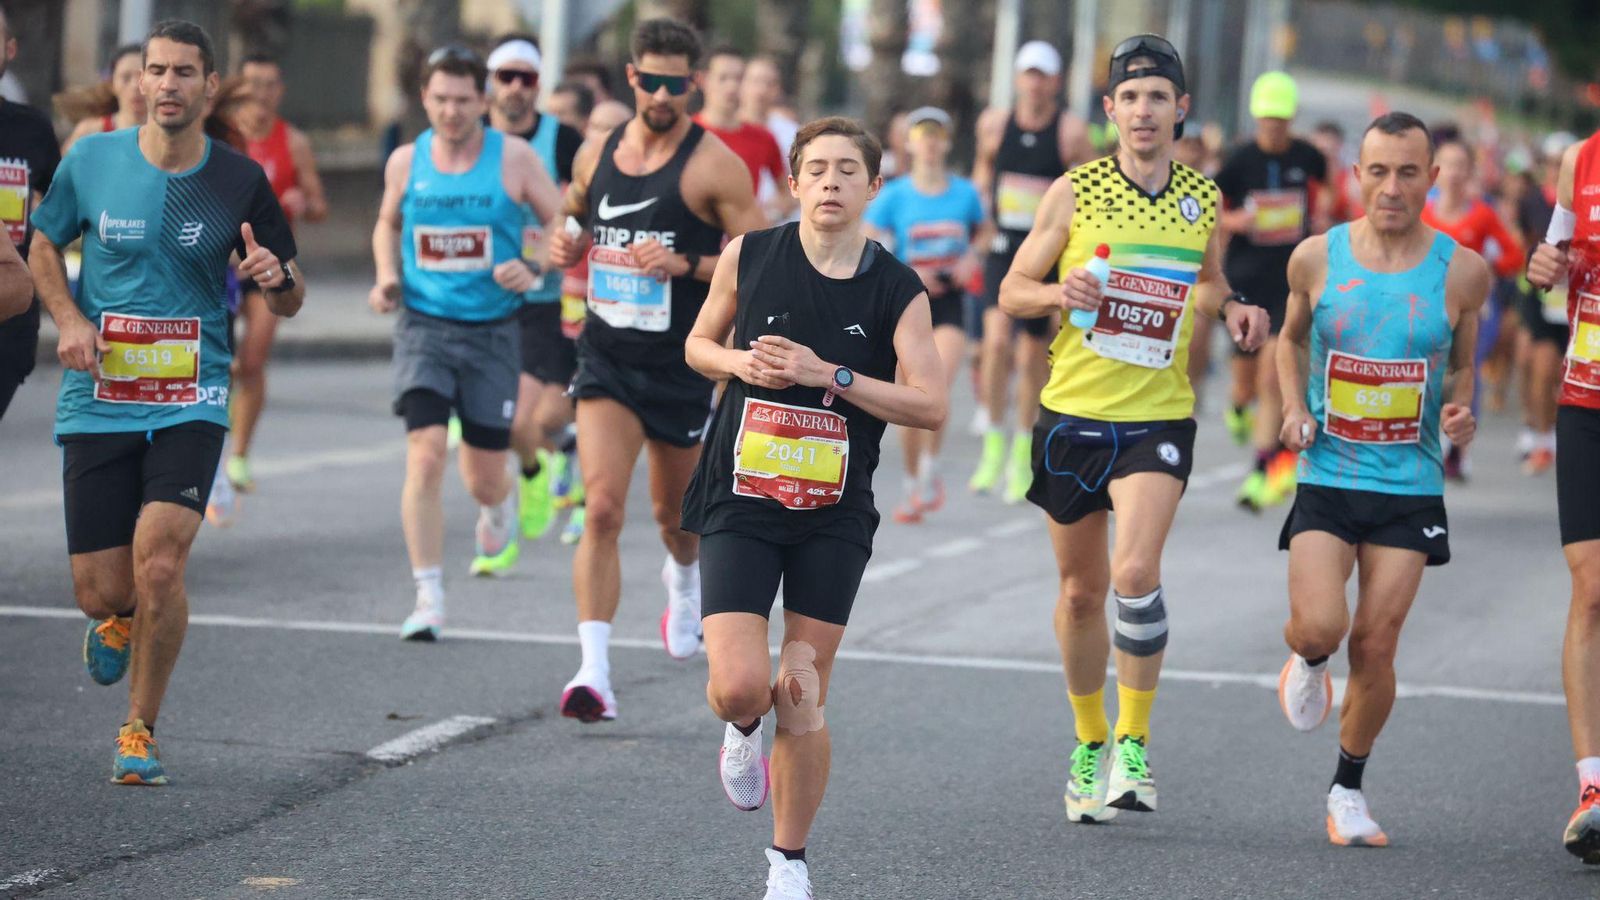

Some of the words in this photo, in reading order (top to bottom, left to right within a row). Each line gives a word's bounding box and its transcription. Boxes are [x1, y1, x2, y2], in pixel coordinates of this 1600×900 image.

[107, 218, 146, 229] OPENLAKES
[1119, 275, 1183, 299] GENERALI
[1108, 301, 1165, 328] 10570
[126, 319, 193, 335] GENERALI
[124, 348, 173, 366] 6519
[1353, 361, 1419, 378] GENERALI
[1355, 388, 1392, 407] 629
[771, 409, 842, 433] GENERALI
[765, 441, 817, 465] 2041
[806, 487, 827, 497] 42K
